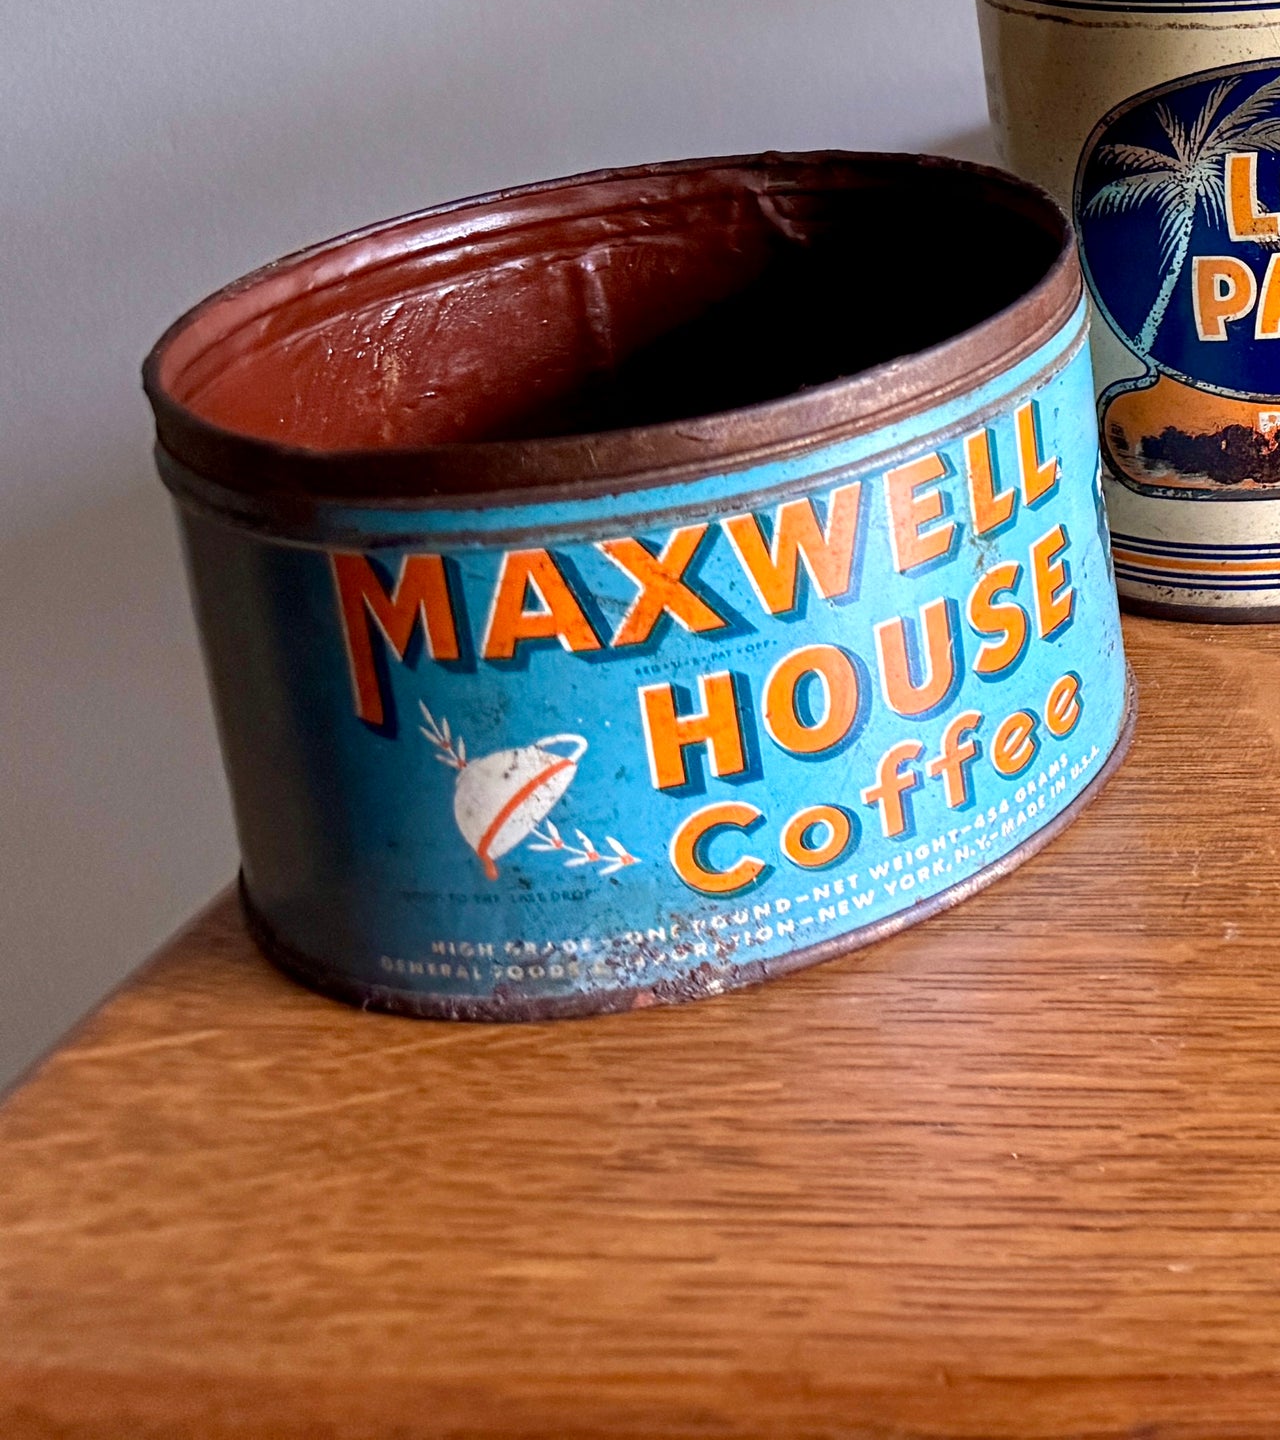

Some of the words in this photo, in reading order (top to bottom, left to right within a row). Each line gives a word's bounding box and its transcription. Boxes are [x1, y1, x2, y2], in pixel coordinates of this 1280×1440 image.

[330, 400, 1062, 727] MAXWELL
[638, 523, 1075, 791] HOUSE
[431, 939, 494, 957] HIGH
[1015, 752, 1069, 804] GRAMS
[668, 673, 1081, 894] Coffee
[1050, 775, 1067, 799] IN
